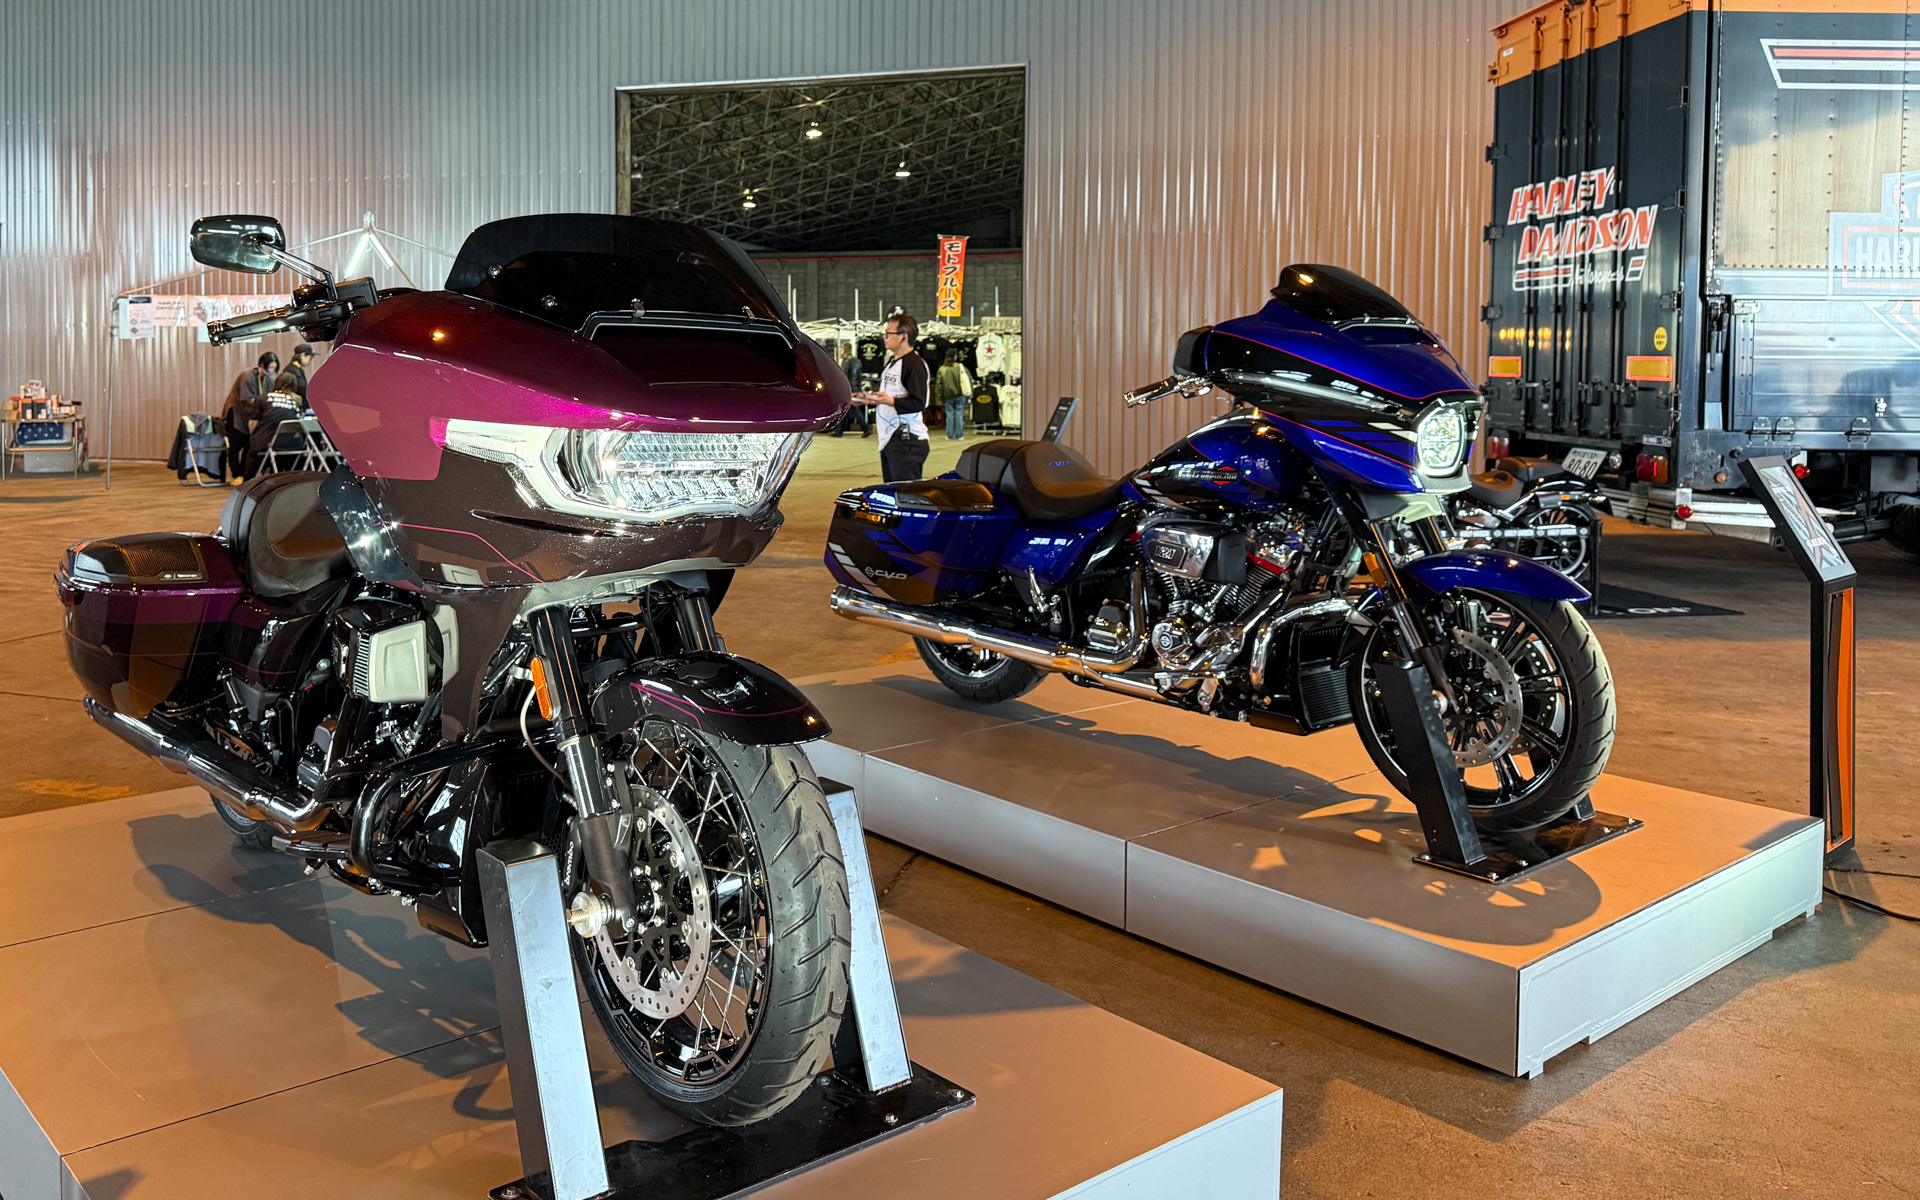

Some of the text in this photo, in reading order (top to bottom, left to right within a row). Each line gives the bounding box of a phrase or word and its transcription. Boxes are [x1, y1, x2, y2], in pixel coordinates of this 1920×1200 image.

[1517, 204, 1659, 264] DAVIDSON
[874, 569, 908, 580] CVO
[562, 841, 574, 887] brembo
